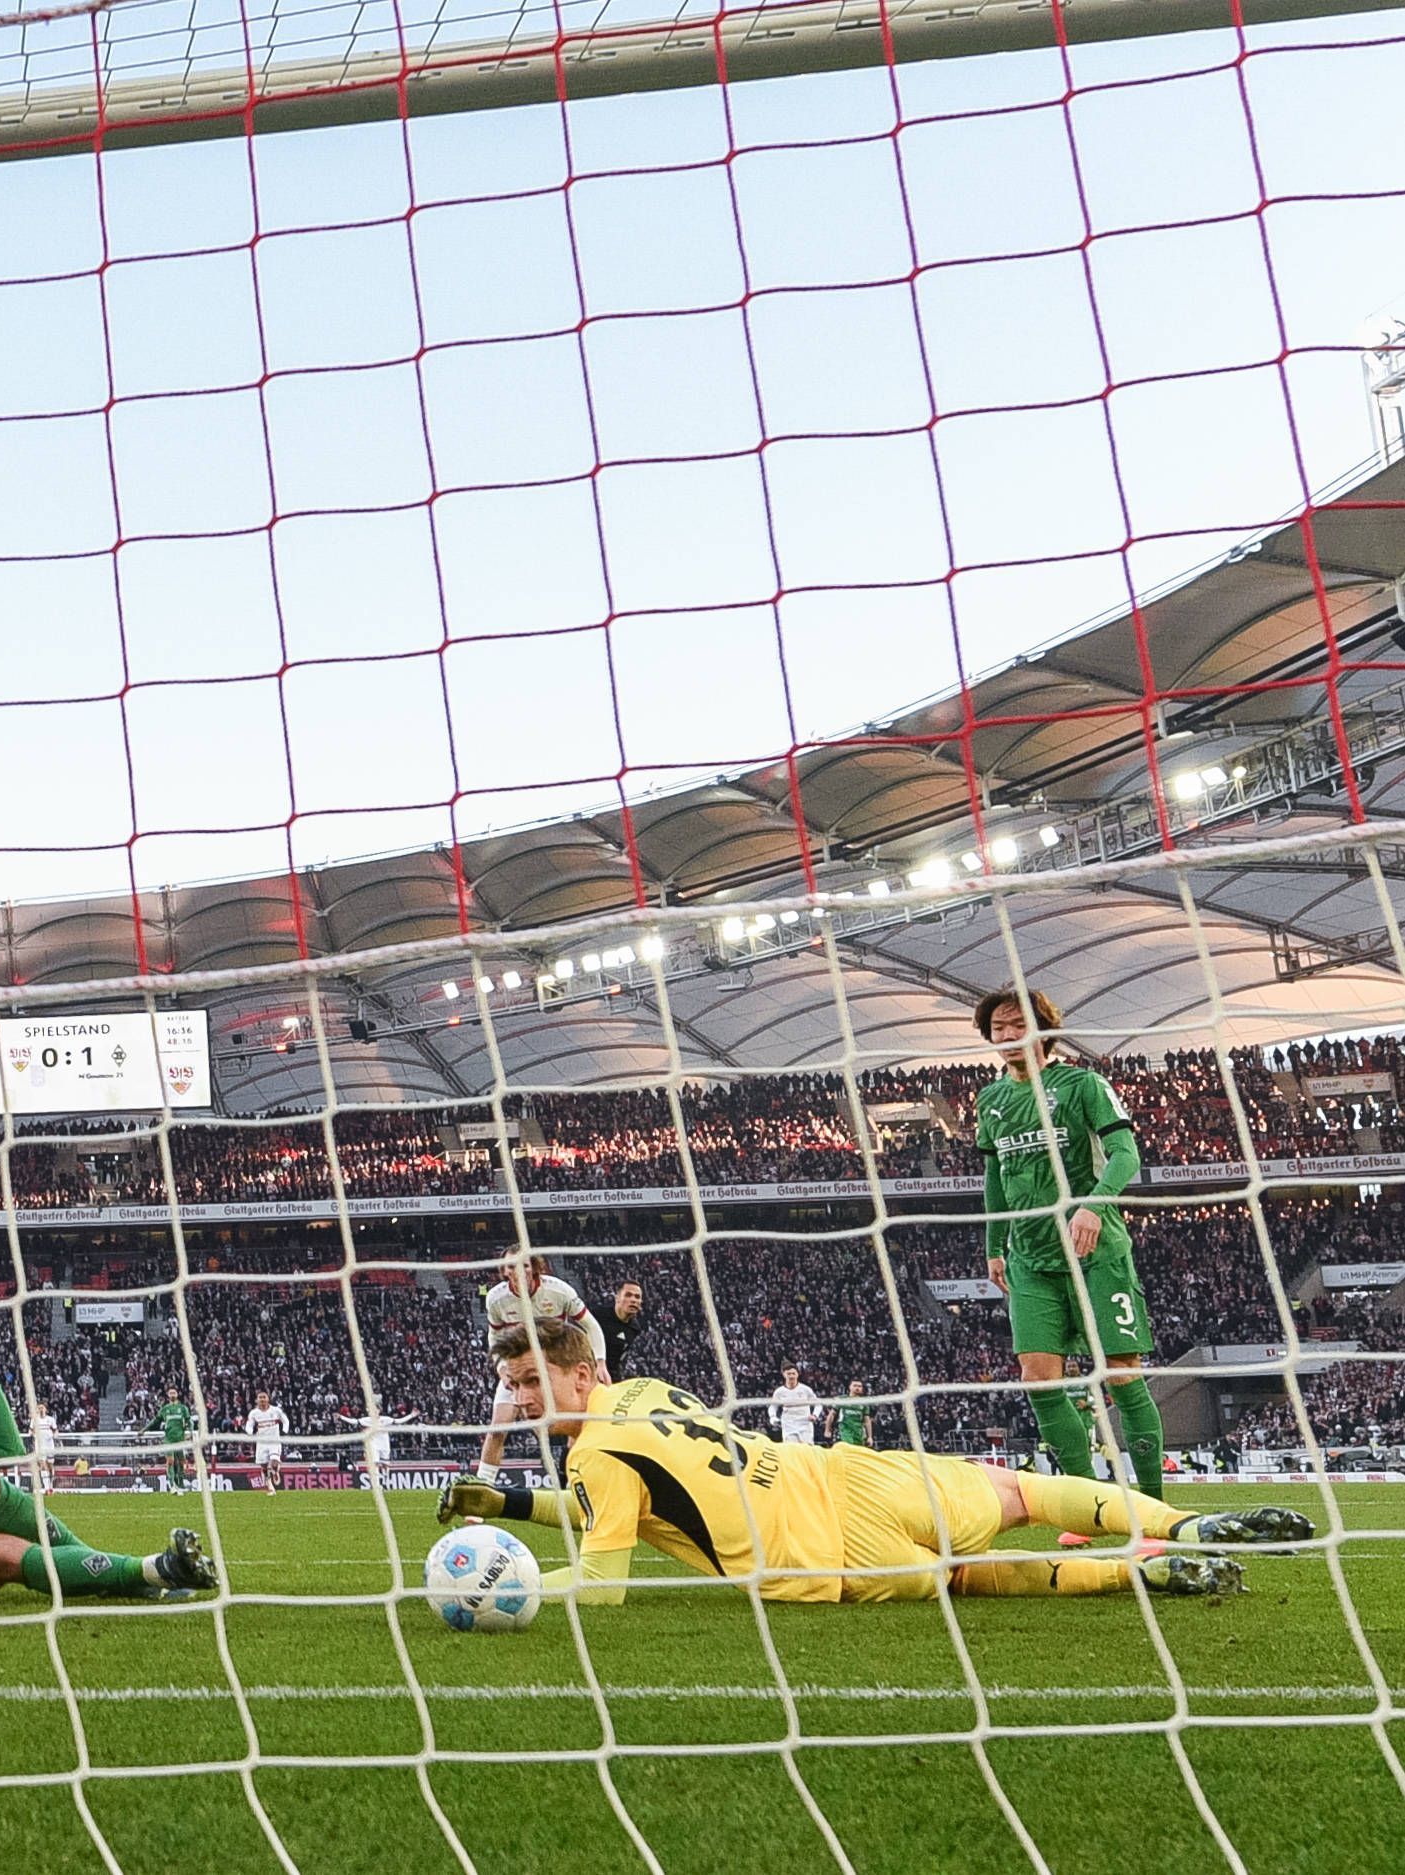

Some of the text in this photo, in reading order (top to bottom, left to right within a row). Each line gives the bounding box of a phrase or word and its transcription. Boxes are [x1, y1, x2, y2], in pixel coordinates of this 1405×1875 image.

[24, 1024, 111, 1037] SPIELSTAND
[1353, 1156, 1401, 1170] Hofbräu
[1224, 1163, 1272, 1177] Hofu
[953, 1178, 984, 1191] Hofbr
[492, 1195, 531, 1207] Hofäu
[661, 1189, 715, 1201] Stuttrter
[174, 1206, 206, 1218] ofbräu
[330, 1200, 382, 1213] Sttgarter
[1111, 1292, 1135, 1326] 3
[284, 1474, 354, 1490] FRESHE
[464, 1553, 510, 1610] DERBYSAR
